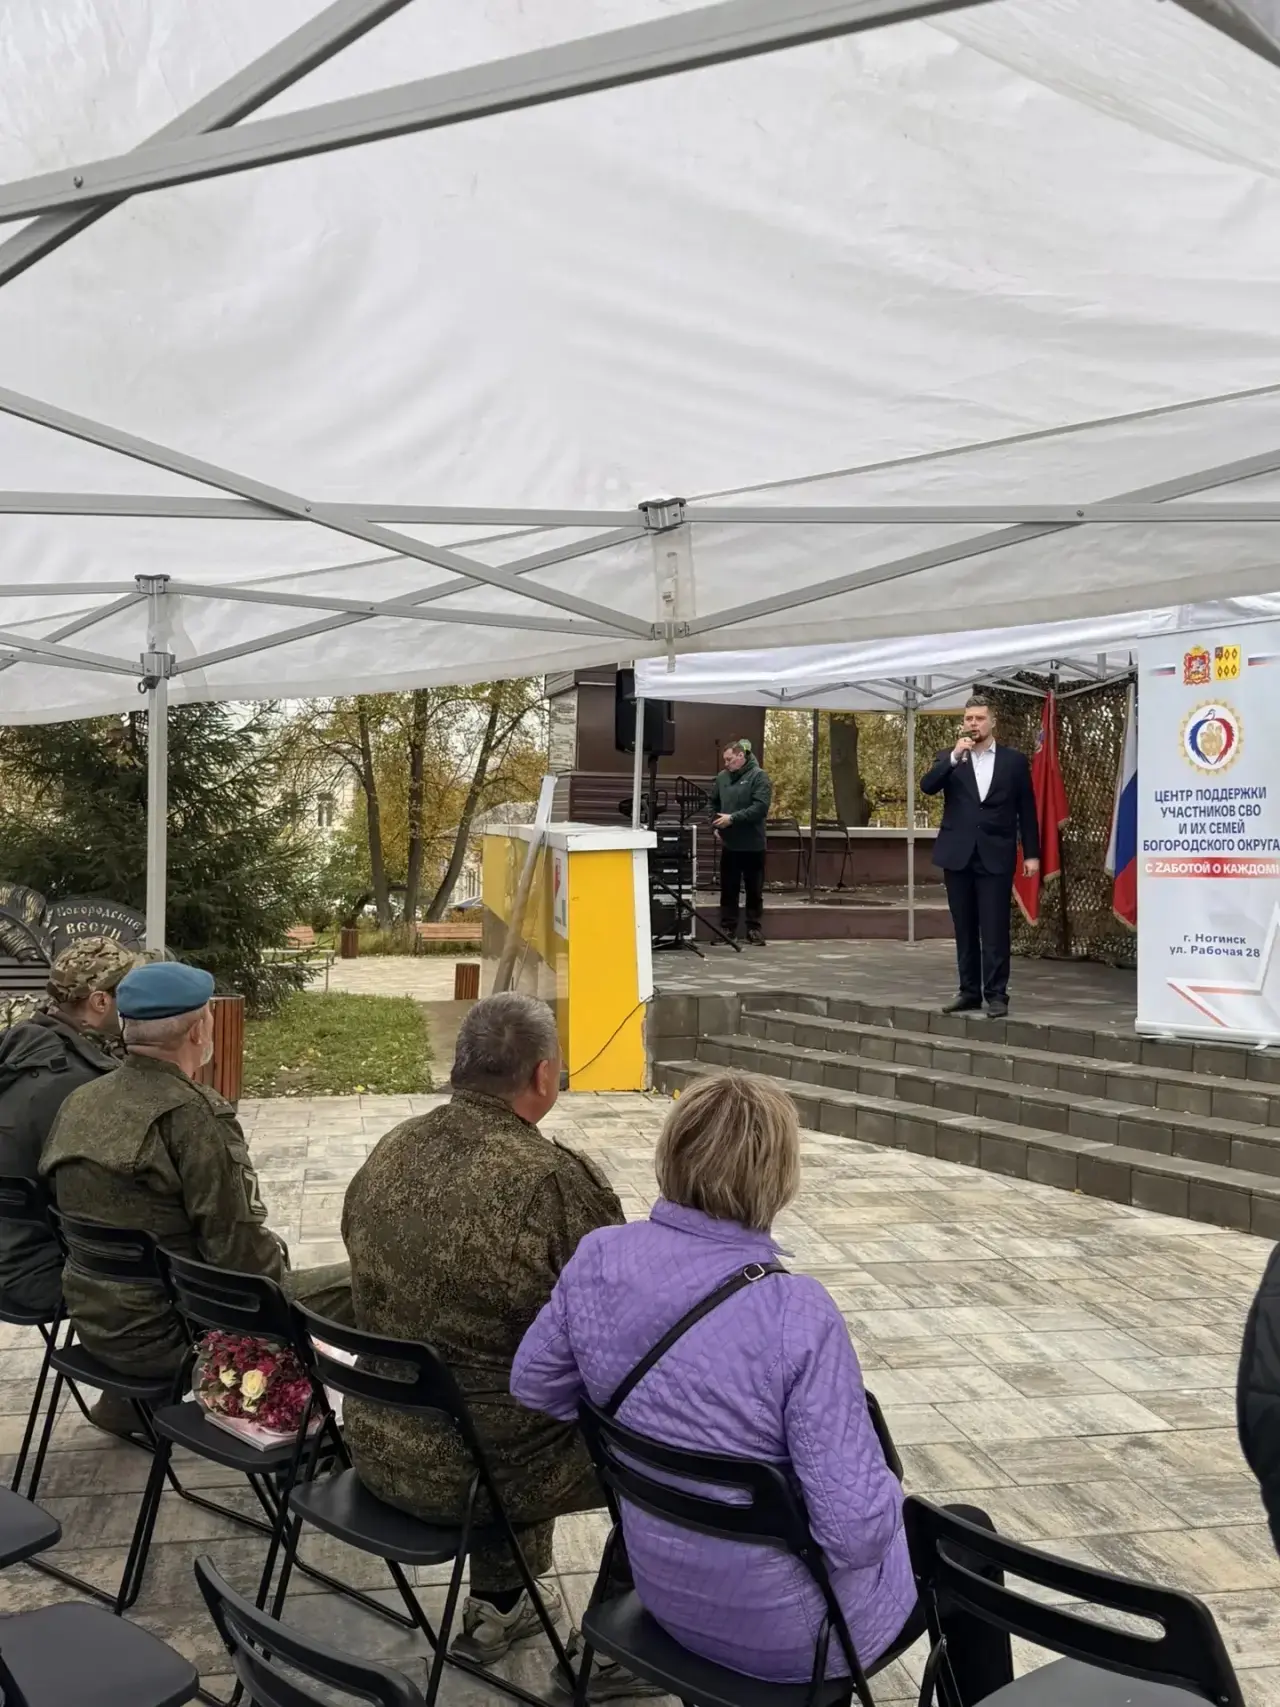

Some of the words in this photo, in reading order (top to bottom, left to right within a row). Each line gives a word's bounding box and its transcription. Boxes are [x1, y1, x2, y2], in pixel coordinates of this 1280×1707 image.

[1154, 790, 1193, 803] ЦЕНТР
[1196, 787, 1267, 802] ПОДДЕРЖКИ
[1161, 805, 1236, 818] УЧАСТНИКОВ
[1238, 804, 1262, 817] СВО
[1179, 823, 1187, 834] И
[1190, 822, 1207, 834] ИХ
[1209, 819, 1245, 834] СЕМЕЙ
[1143, 839, 1235, 852] БОГОРОДСКОГО
[1237, 839, 1280, 851] ОКРУГА
[1212, 863, 1222, 873] О
[1183, 935, 1191, 943] г.
[1195, 934, 1246, 944] Ногинск
[1169, 946, 1187, 955] ул.
[1190, 946, 1243, 957] Рабочая
[1246, 948, 1261, 958] 28
